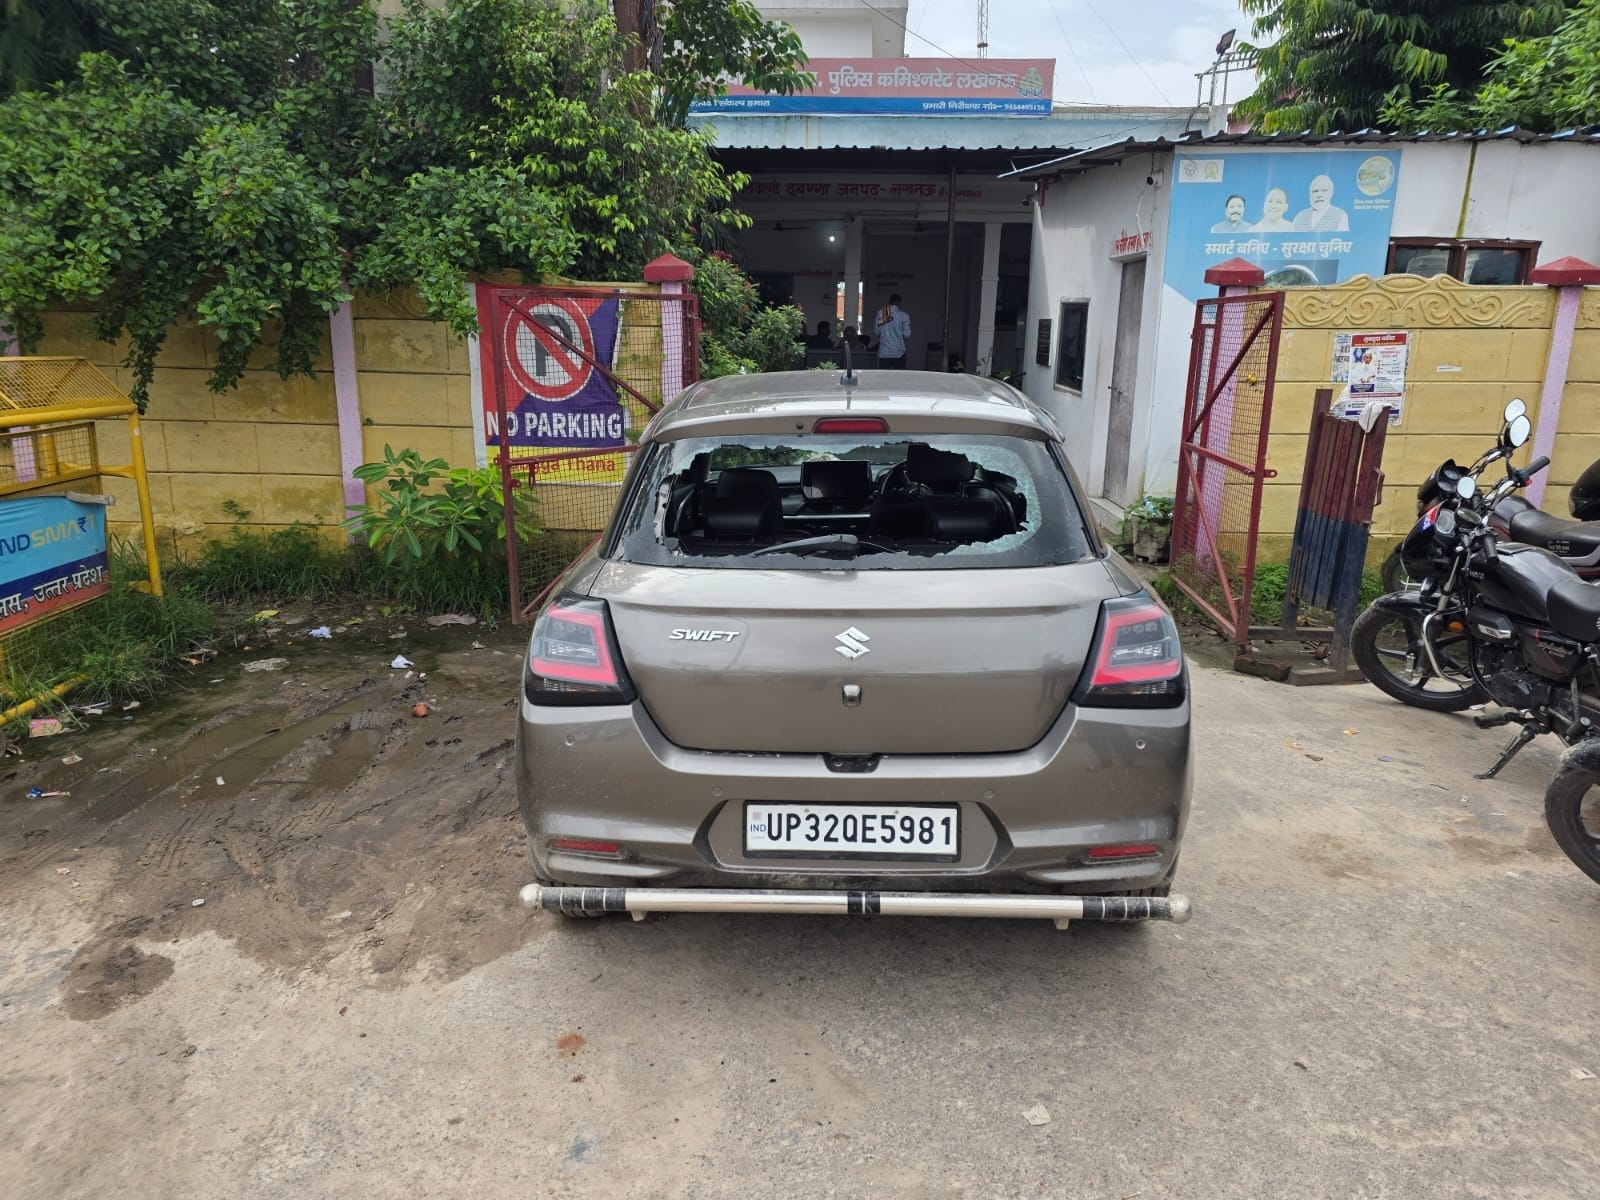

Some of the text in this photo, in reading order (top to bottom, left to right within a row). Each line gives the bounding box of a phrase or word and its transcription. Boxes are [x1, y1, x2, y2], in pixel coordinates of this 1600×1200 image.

[828, 66, 874, 94] पुलिस
[877, 66, 954, 88] कमिश्नरेट
[956, 72, 1017, 89] लखनऊ
[1205, 239, 1234, 255] स्मार्ट
[1237, 239, 1271, 254] बनिए
[1281, 240, 1316, 258] सुरक्षा
[1319, 238, 1353, 258] चुनिए
[525, 412, 622, 439] PARKING
[33, 575, 69, 603] उत्तर
[72, 564, 103, 591] प्रदेश
[668, 628, 740, 643] SWIFT
[750, 813, 951, 845] IND UP32QE5981
